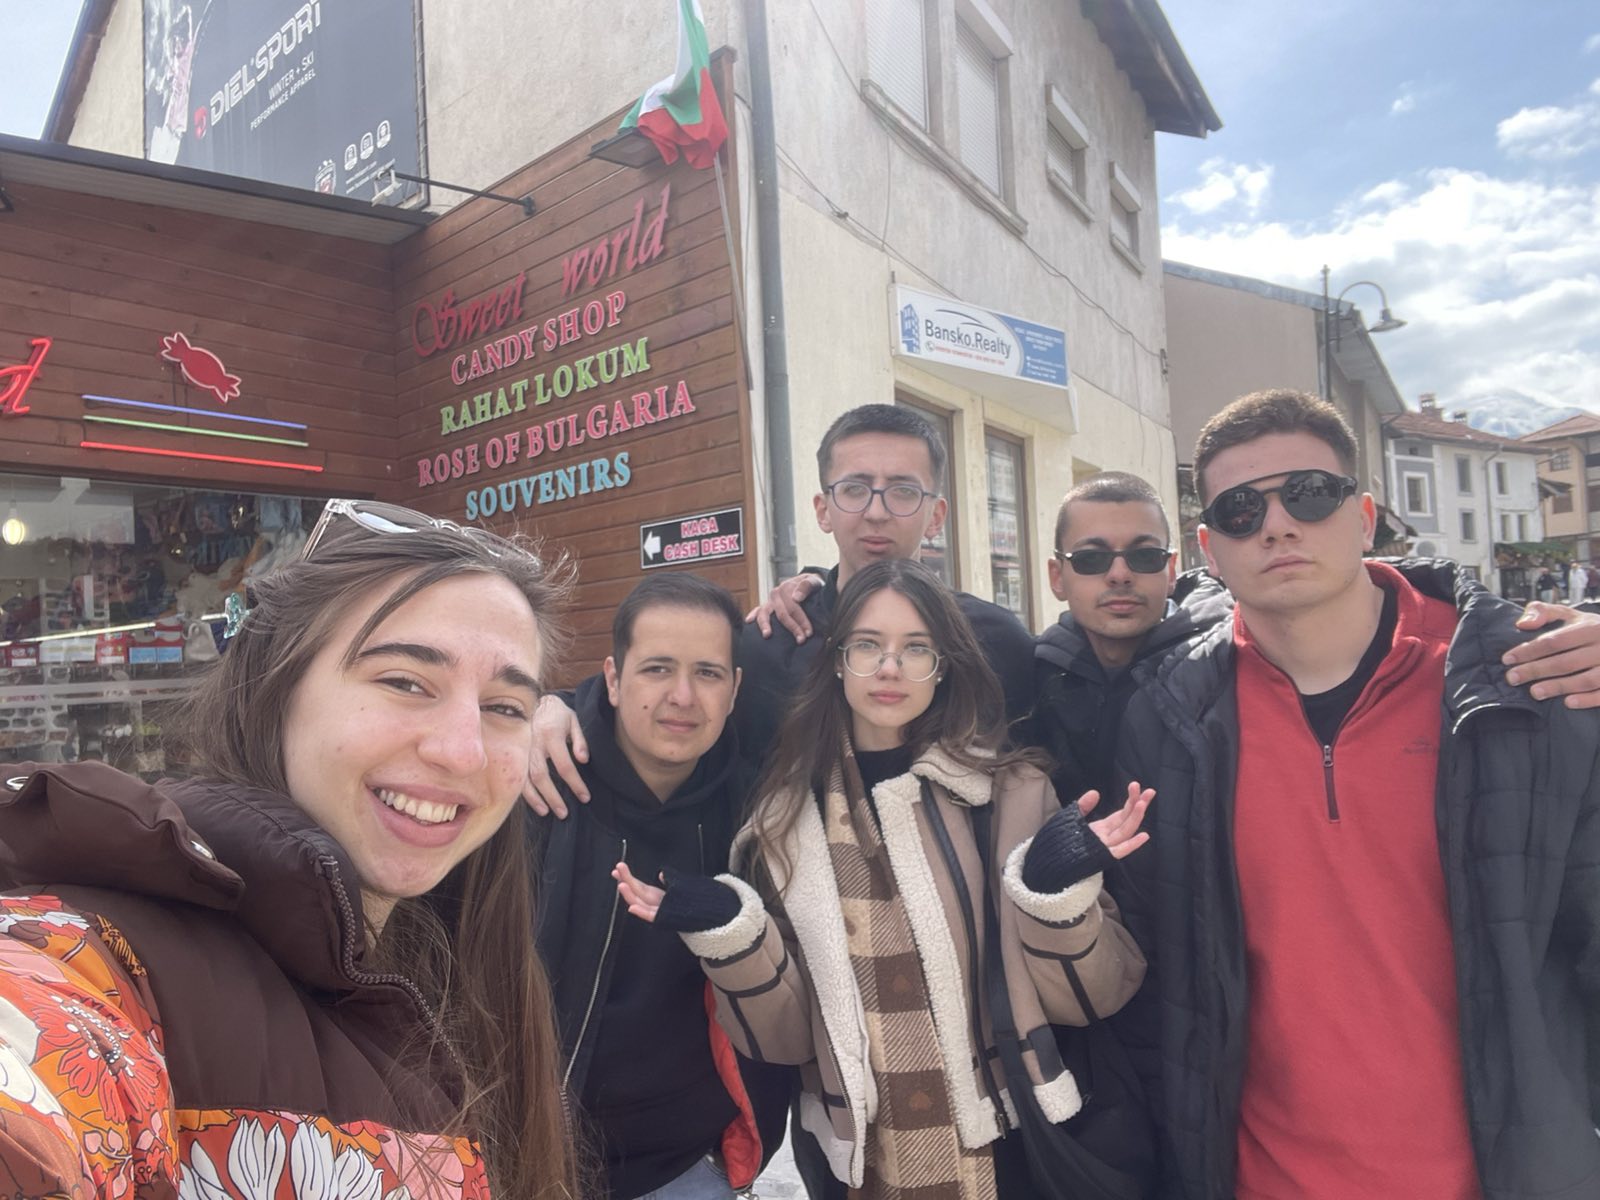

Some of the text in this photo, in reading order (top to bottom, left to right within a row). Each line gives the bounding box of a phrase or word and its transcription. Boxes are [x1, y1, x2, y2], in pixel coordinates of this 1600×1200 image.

[250, 68, 316, 131] PERFORMANCE APPAREL
[268, 68, 295, 100] WINTER
[301, 51, 314, 71] SKI
[412, 182, 671, 357] Sweet world
[451, 290, 626, 386] CANDY SHOP
[924, 319, 1012, 359] Bansko.Realty
[440, 337, 651, 435] RAHAT LOKUM
[417, 380, 696, 488] ROSE OF BULGARIA
[465, 452, 631, 521] SOUVENIRS
[663, 533, 739, 561] CASH DESK
